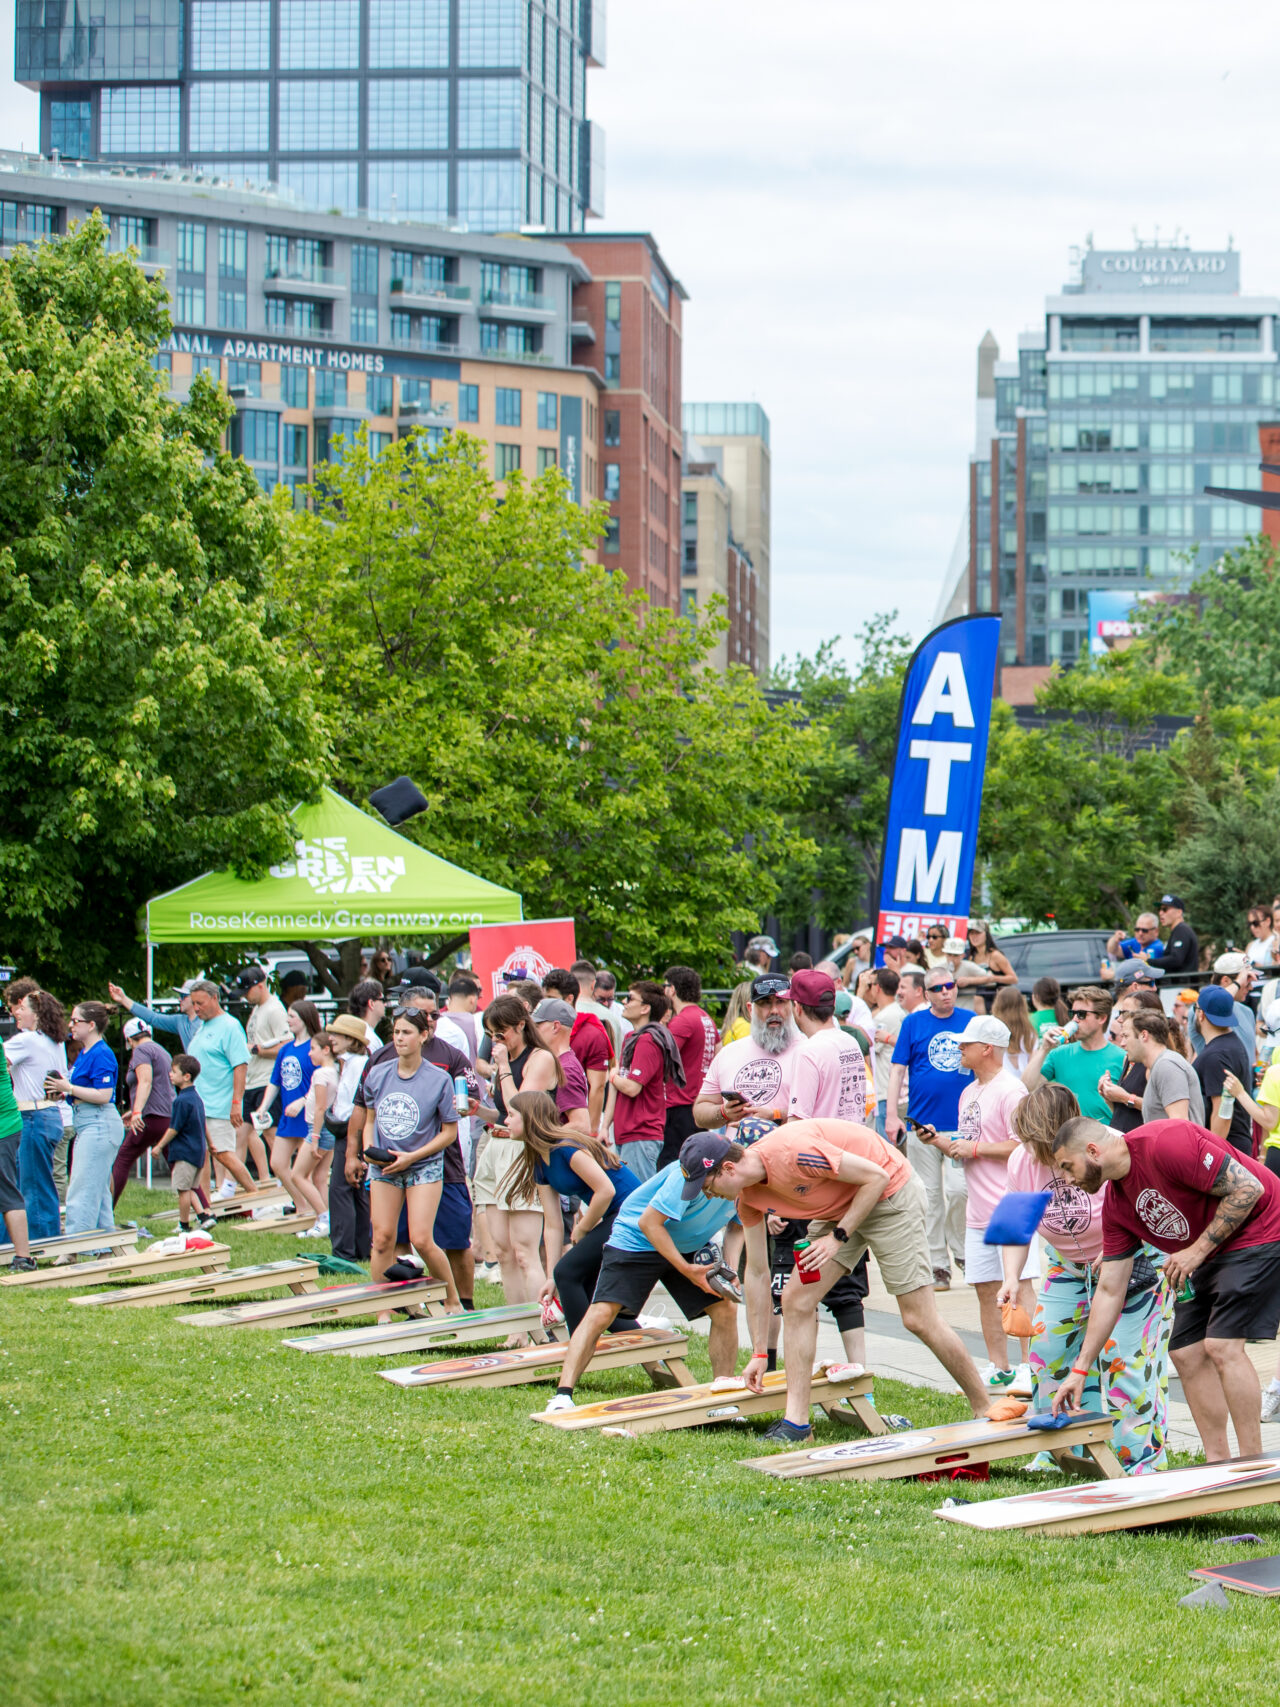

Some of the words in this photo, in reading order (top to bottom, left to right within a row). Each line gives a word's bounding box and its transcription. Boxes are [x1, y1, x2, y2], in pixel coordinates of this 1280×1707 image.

[1101, 256, 1227, 273] COURTYARD
[222, 339, 324, 366] APARTMENT
[327, 351, 385, 373] HOMES
[893, 651, 976, 905] ATM
[295, 837, 349, 863] HE
[269, 855, 407, 879] GREEN
[309, 874, 400, 894] WAY
[189, 910, 484, 930] RoseKennedyGreenway.org
[838, 1052, 863, 1065] SPONSORS
[1069, 1209, 1089, 1217] CLASSIC
